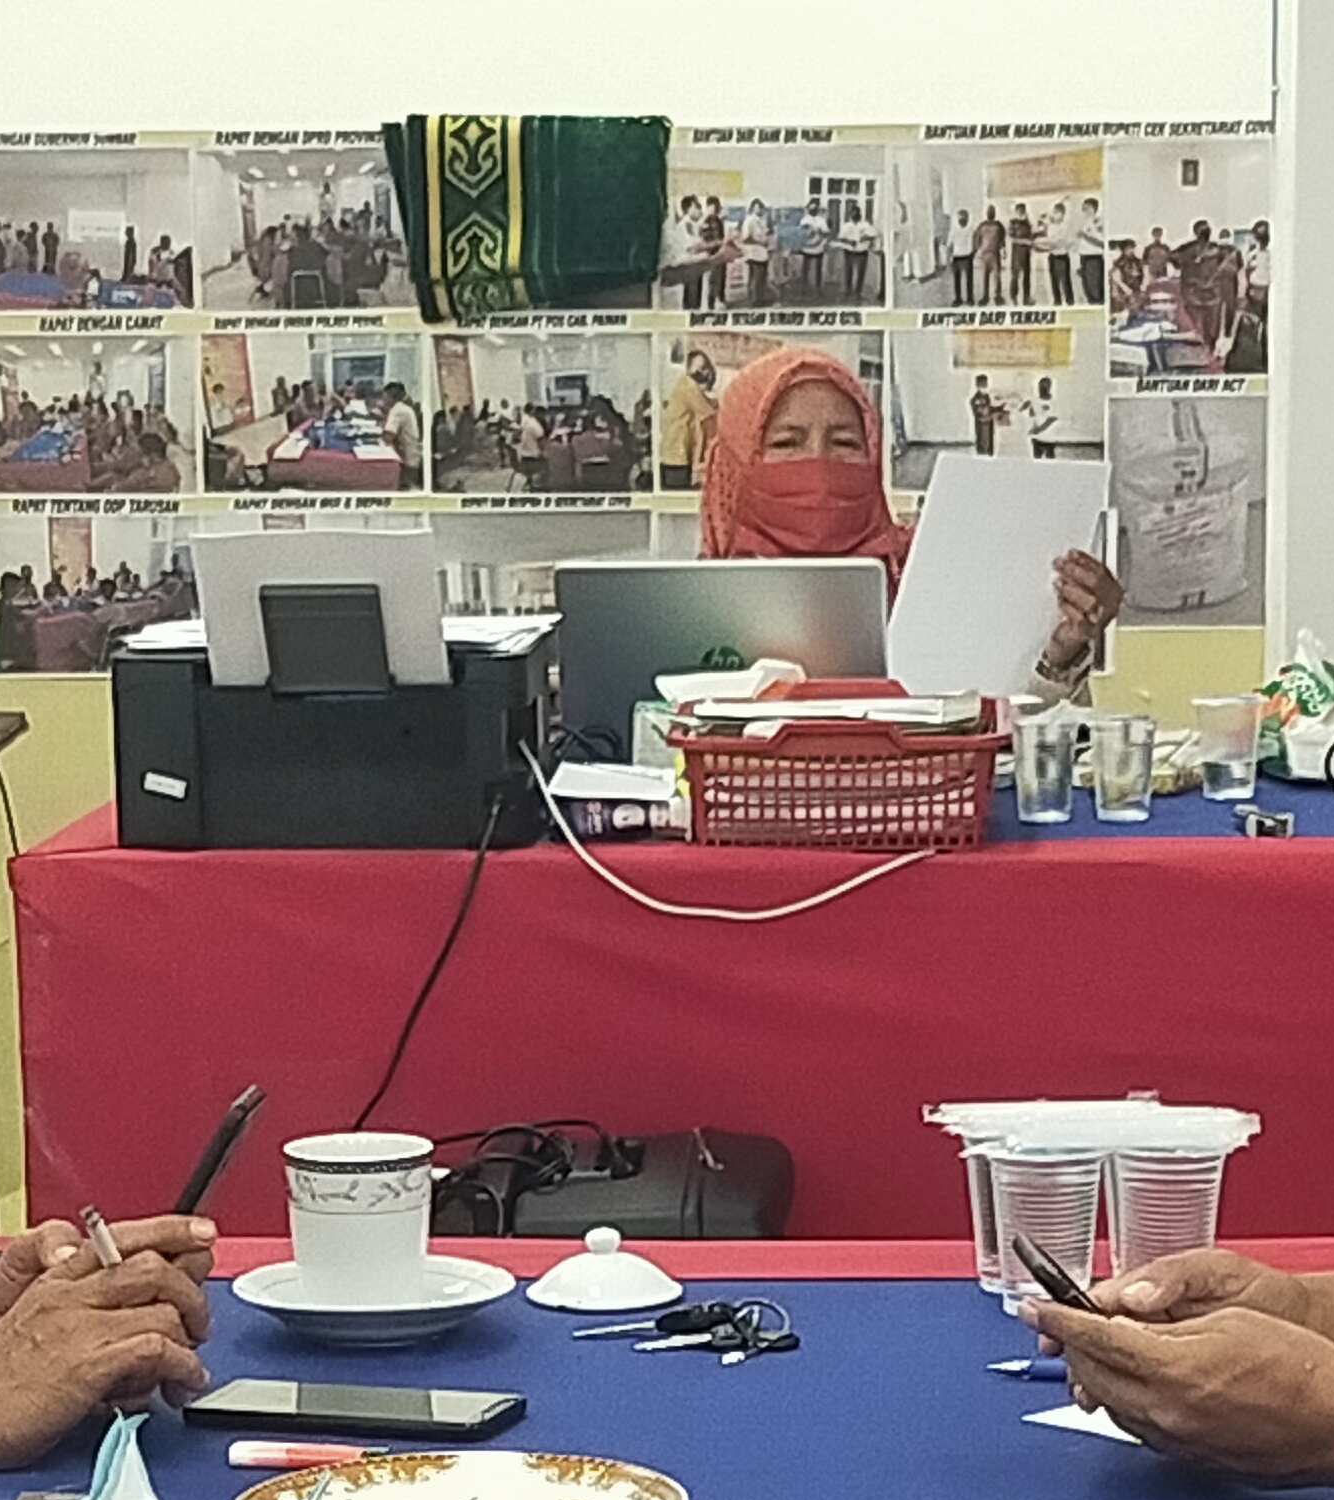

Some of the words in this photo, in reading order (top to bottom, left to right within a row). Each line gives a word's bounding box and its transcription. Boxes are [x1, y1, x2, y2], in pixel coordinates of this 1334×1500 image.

[1143, 122, 1167, 136] CEK
[216, 131, 252, 146] RAPAT
[253, 131, 300, 146] DENGAN
[302, 131, 332, 145] DPRD
[39, 316, 75, 331] RAPAT
[77, 316, 123, 332] DENGAN
[922, 312, 976, 327] BANTUAN
[978, 312, 1008, 327] DARI
[1136, 379, 1190, 393] BANTUAN
[1192, 379, 1220, 393] DARI
[1221, 378, 1246, 392] ACT
[12, 499, 46, 514] RAPAT
[50, 499, 101, 514] TENTANG
[233, 498, 269, 511] RAPAT
[270, 498, 317, 510] DENGAN
